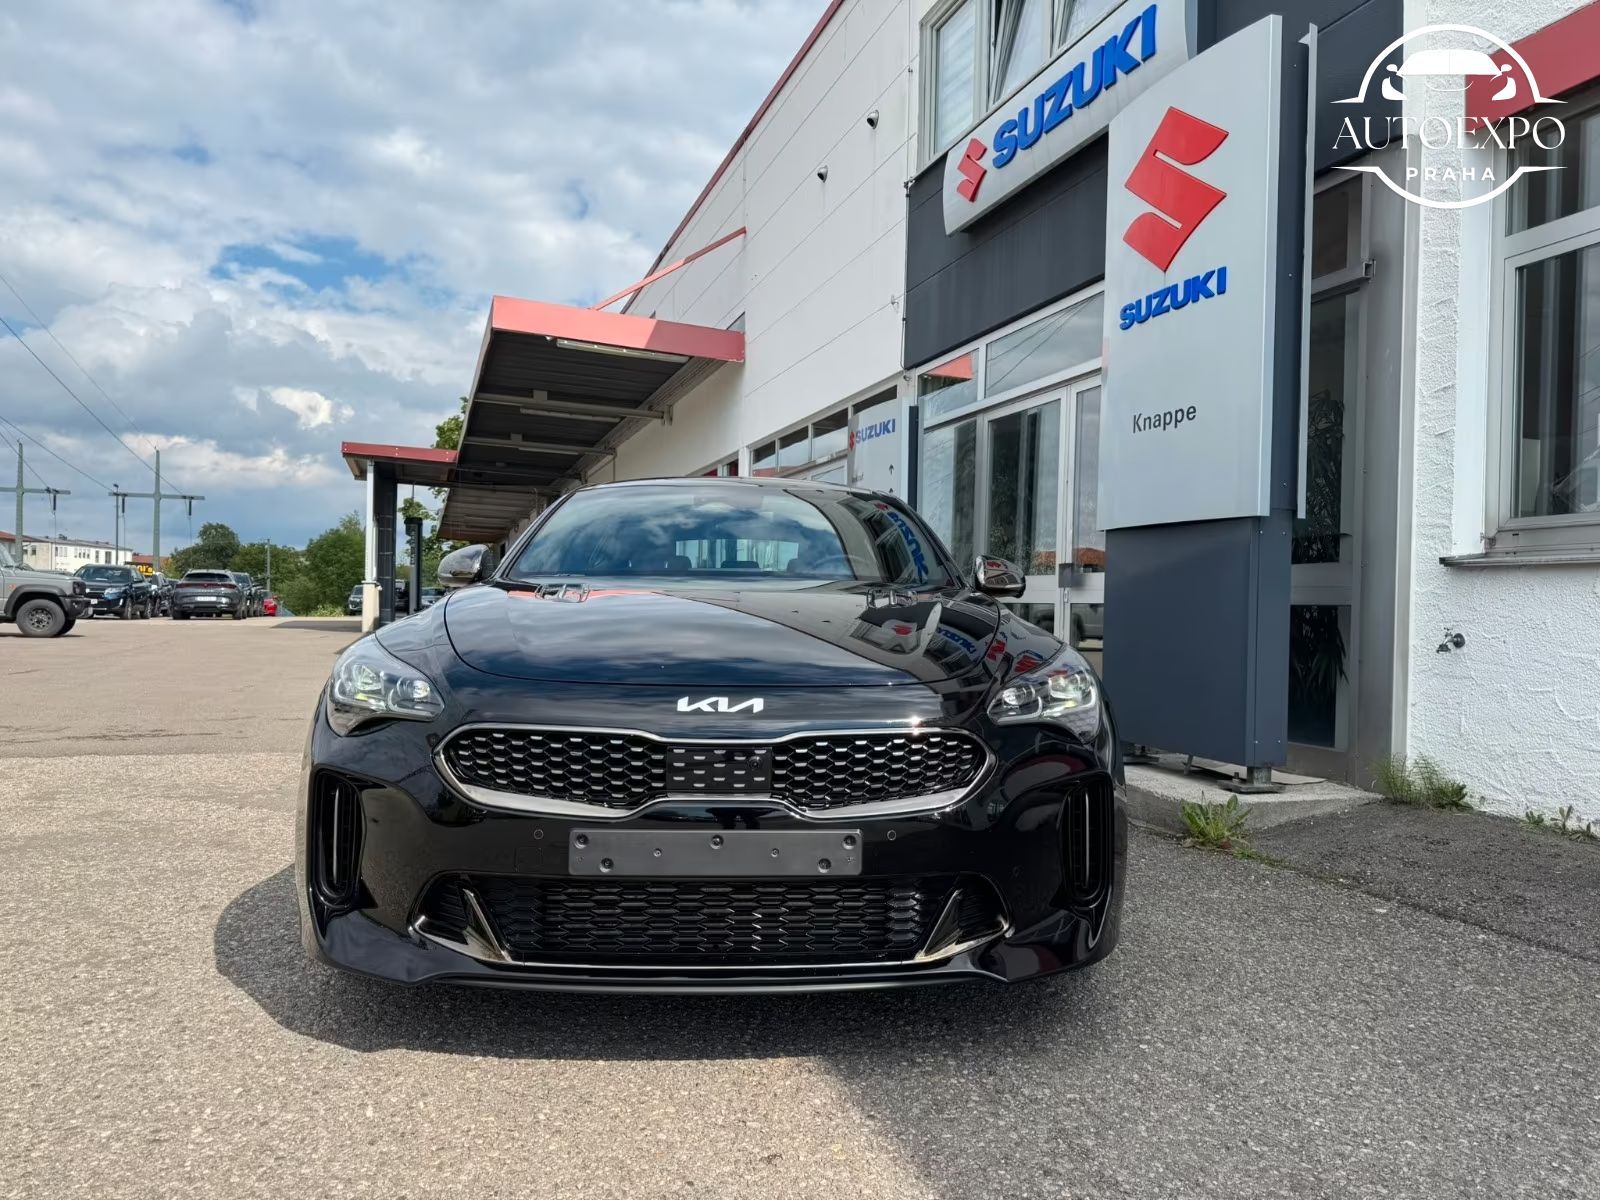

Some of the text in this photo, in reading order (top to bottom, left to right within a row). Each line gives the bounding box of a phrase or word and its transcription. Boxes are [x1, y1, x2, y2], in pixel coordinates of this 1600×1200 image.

[992, 4, 1157, 169] SUZUKI
[1119, 266, 1227, 331] SUZUKI
[856, 418, 896, 444] SUZUKI
[1132, 404, 1197, 434] Knappe
[677, 696, 764, 714] KIA
